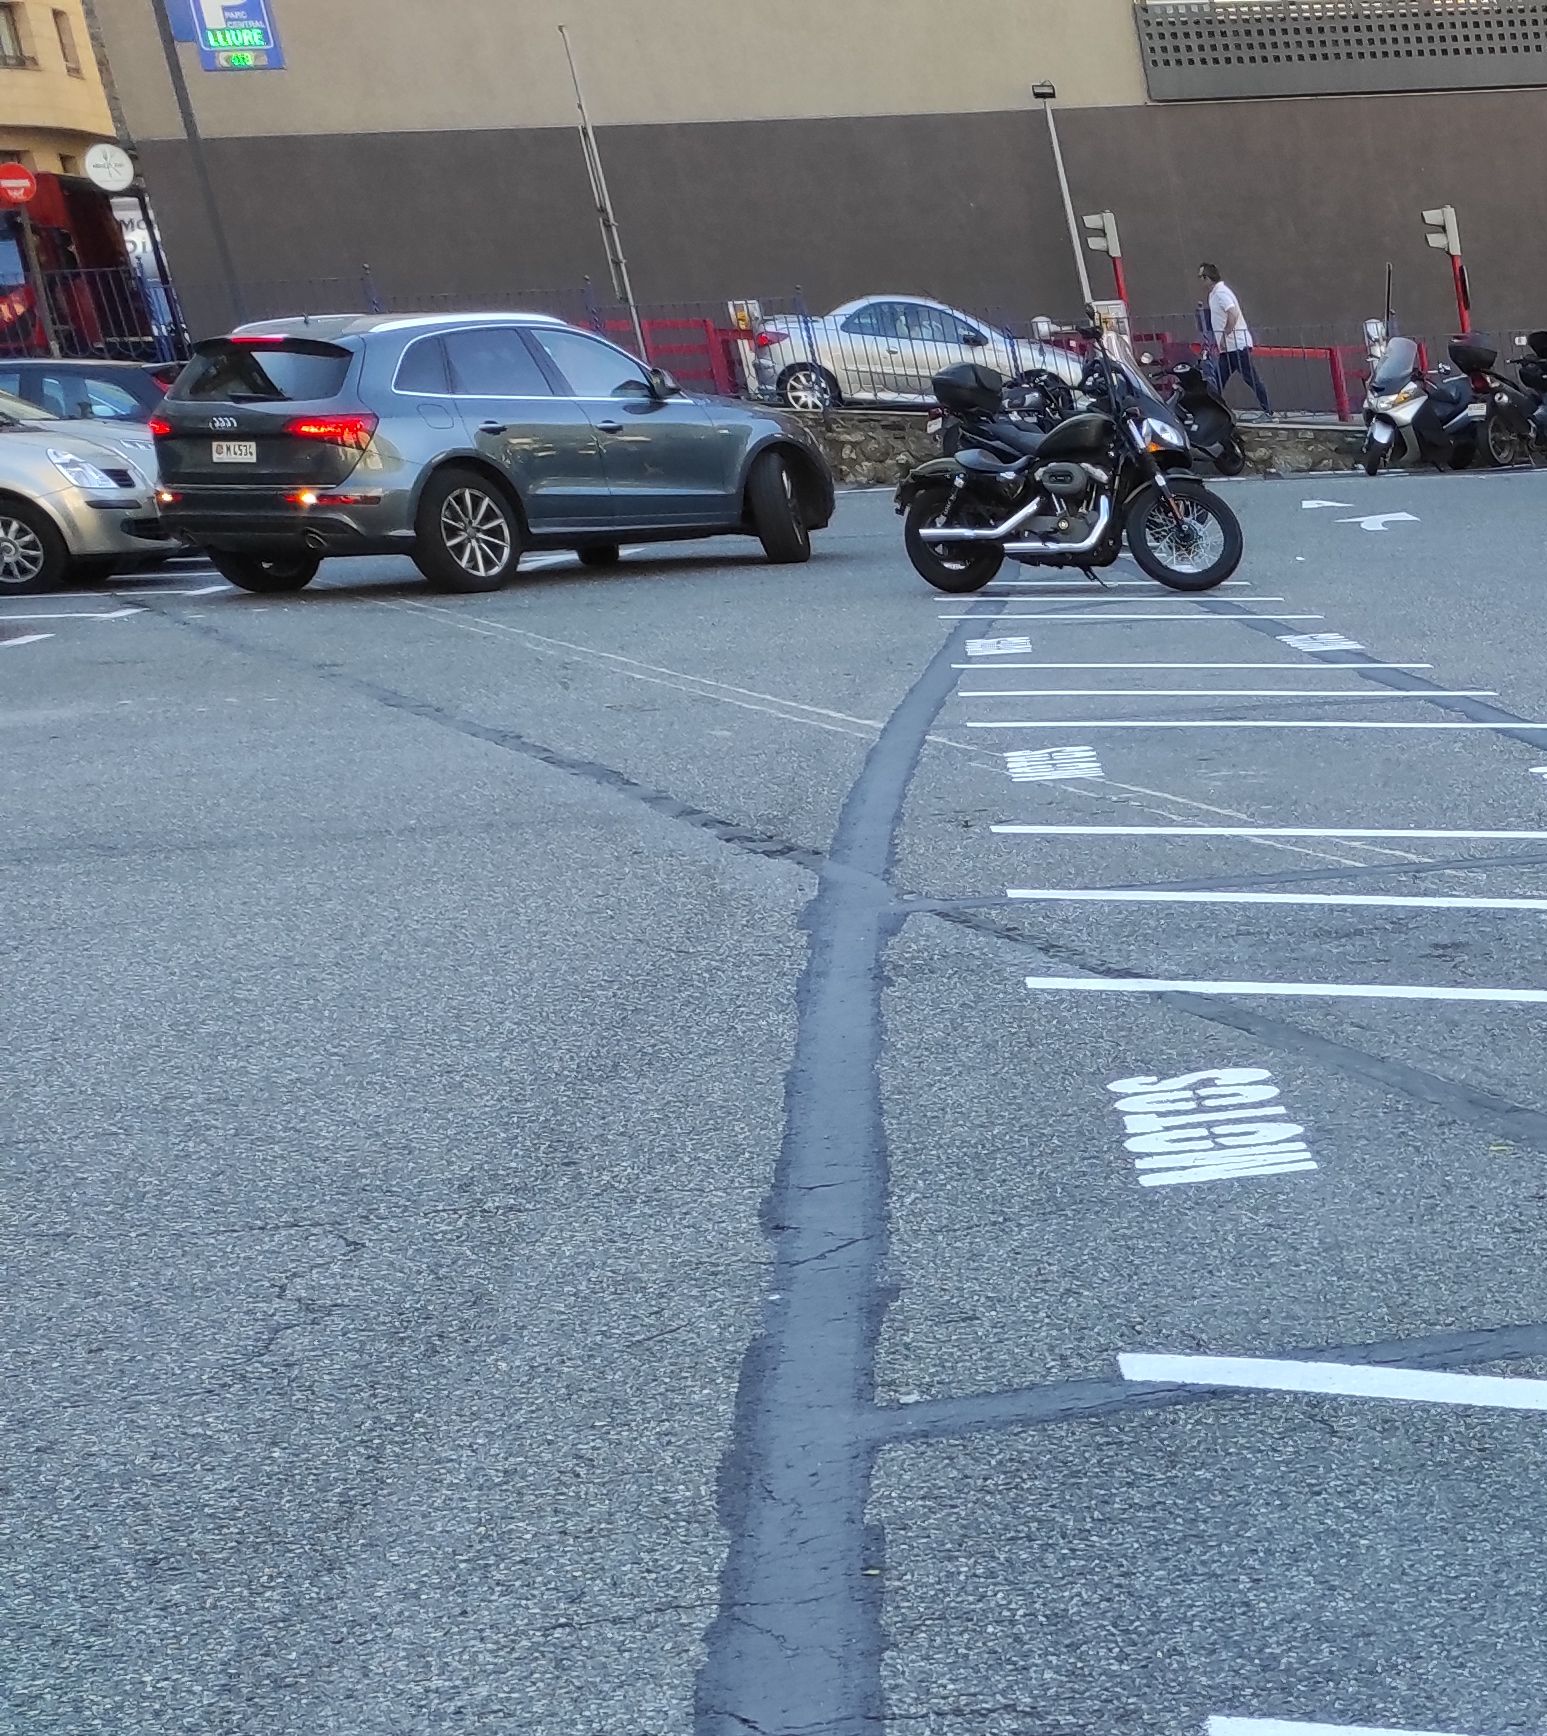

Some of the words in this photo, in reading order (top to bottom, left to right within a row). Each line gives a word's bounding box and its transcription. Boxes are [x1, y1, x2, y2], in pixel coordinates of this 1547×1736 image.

[224, 11, 248, 19] PARC
[227, 20, 265, 28] CENTRAL
[207, 29, 264, 46] LLIURE
[1106, 1067, 1319, 1188] MOTOS
